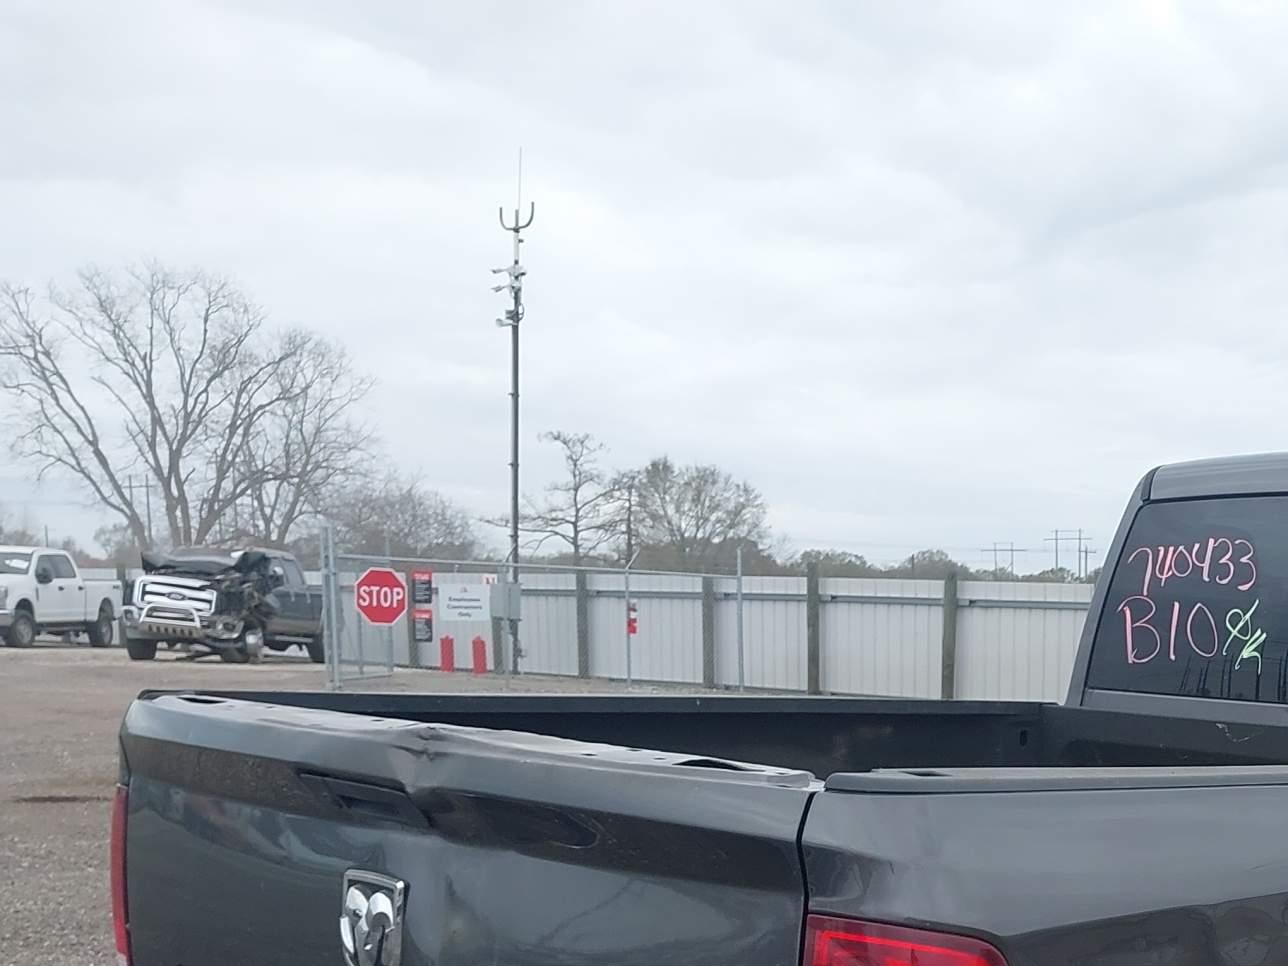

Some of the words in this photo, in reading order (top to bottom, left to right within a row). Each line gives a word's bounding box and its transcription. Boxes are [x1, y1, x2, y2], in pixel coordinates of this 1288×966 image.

[1127, 537, 1257, 596] 740433
[359, 585, 404, 608] STOP
[1116, 595, 1218, 664] B10
